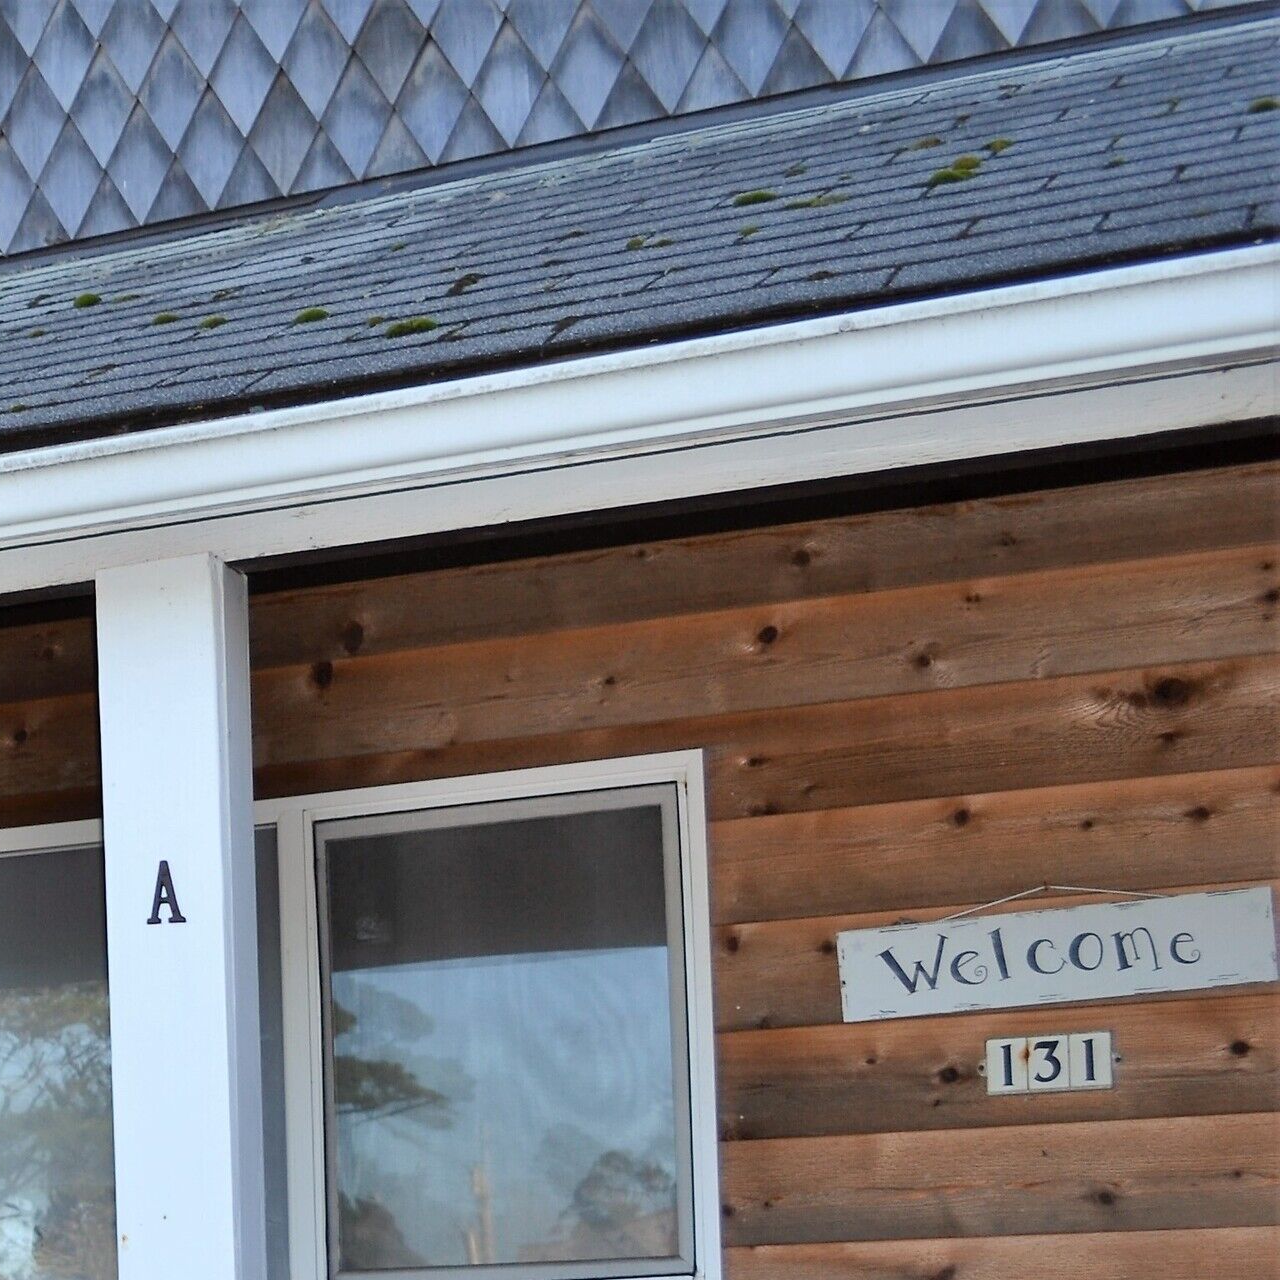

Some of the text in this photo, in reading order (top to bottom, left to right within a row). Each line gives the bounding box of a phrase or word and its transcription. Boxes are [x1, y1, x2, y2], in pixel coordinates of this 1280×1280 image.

[146, 860, 187, 924] A
[875, 924, 1202, 996] Welcome
[999, 1037, 1097, 1088] 131
